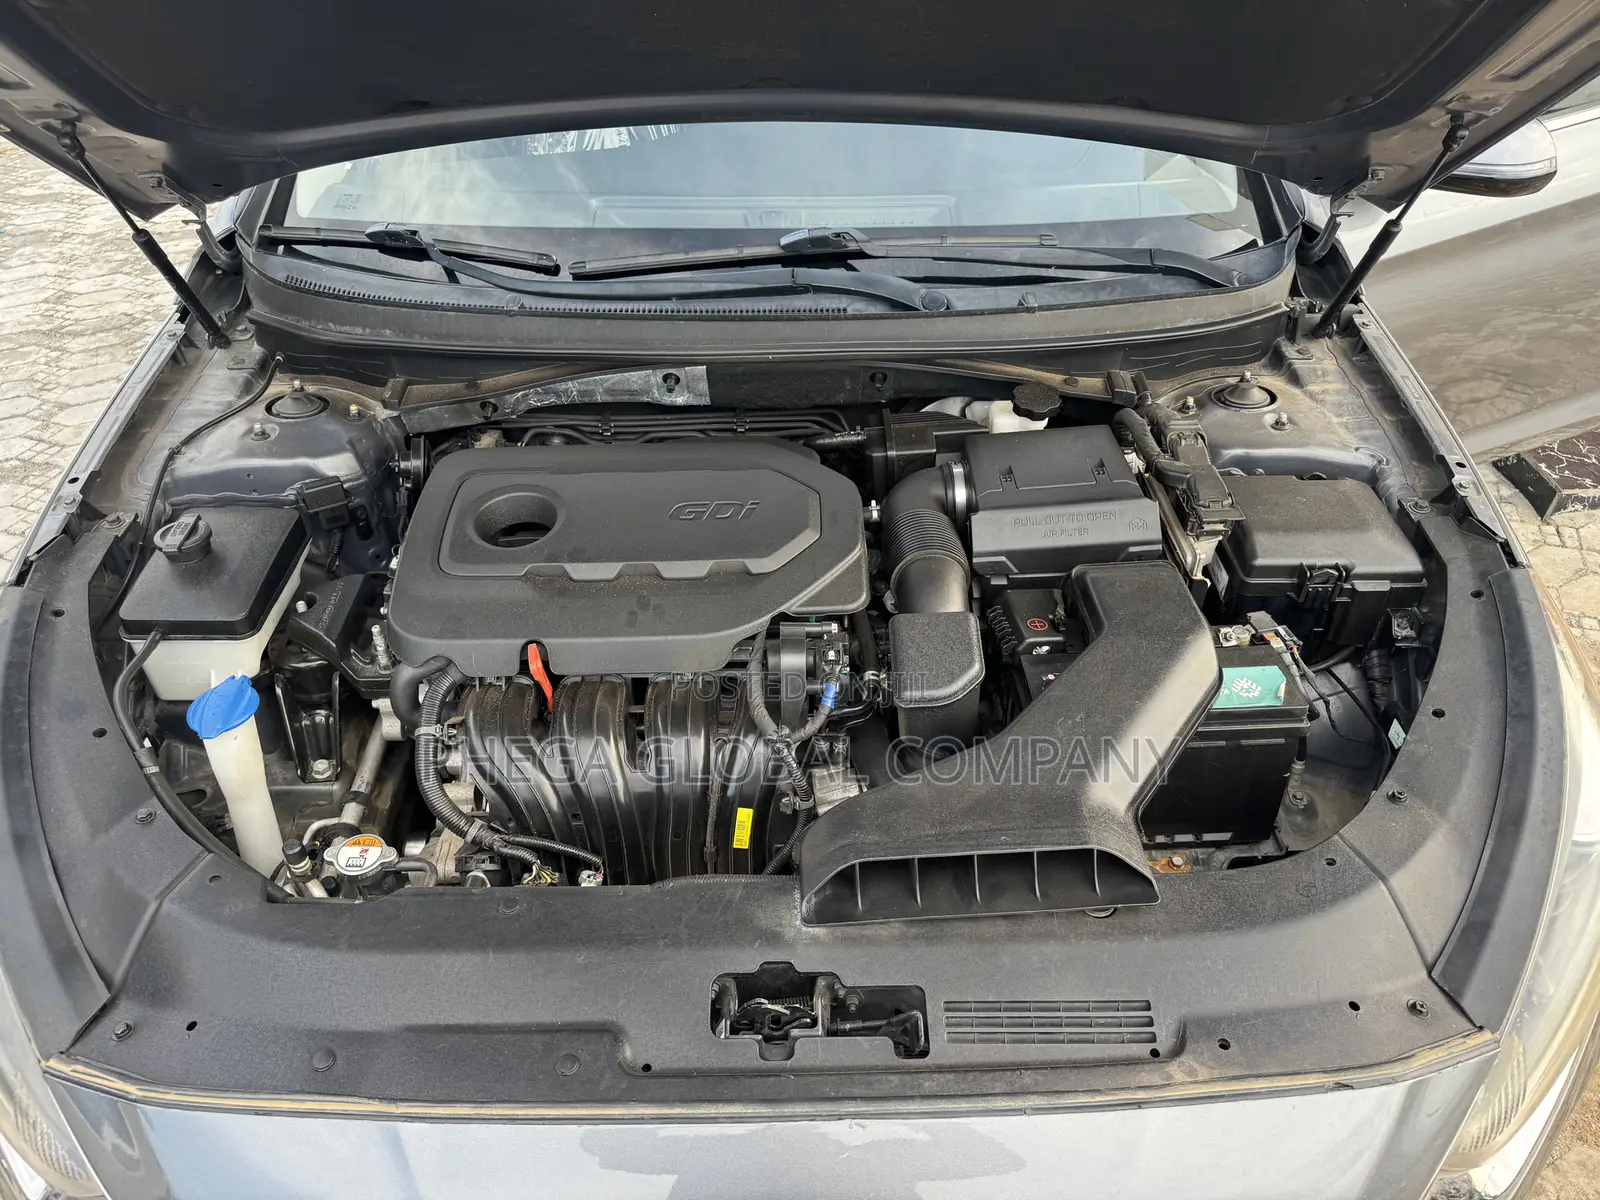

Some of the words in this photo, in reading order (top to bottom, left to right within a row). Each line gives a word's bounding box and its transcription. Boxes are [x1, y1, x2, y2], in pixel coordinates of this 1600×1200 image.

[1013, 516, 1041, 527] PULL
[1044, 514, 1067, 525] OUT
[1069, 512, 1084, 523] TO
[1086, 510, 1117, 521] OPEN
[1042, 529, 1058, 538] AIR
[1060, 527, 1090, 537] FILTER
